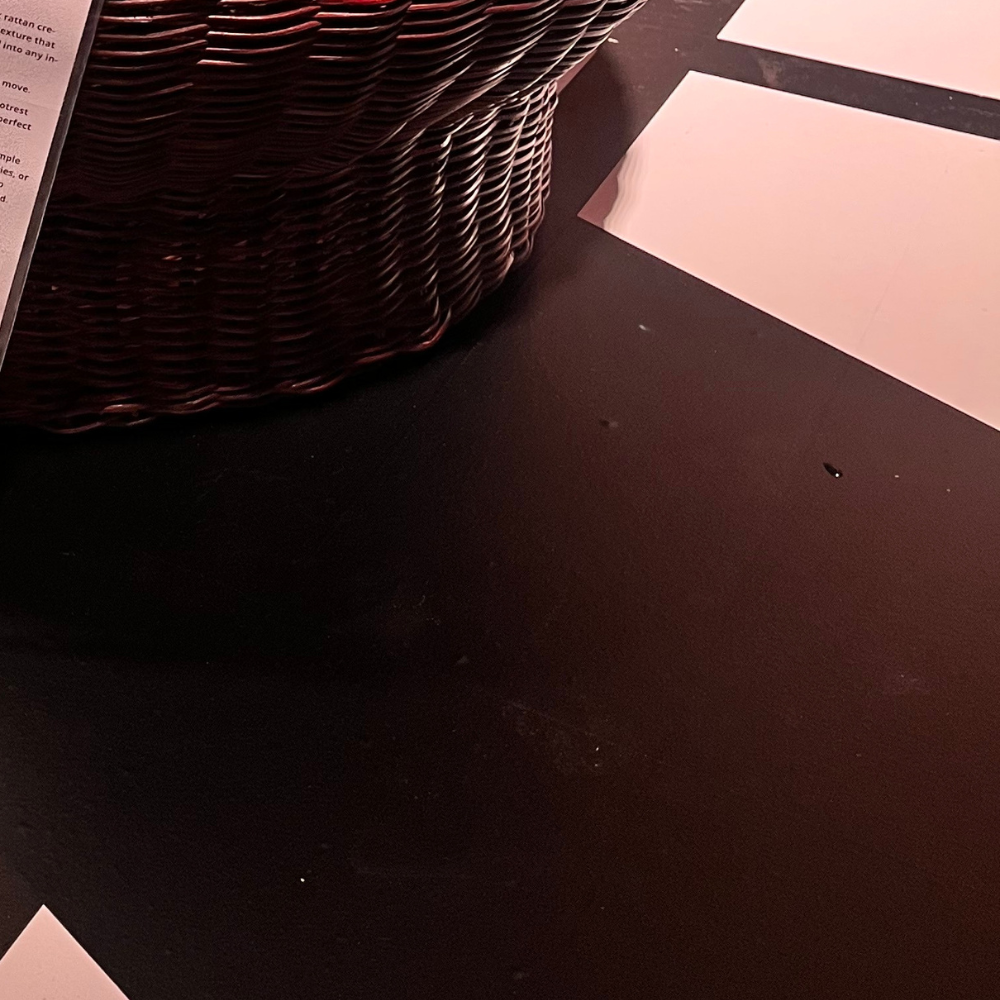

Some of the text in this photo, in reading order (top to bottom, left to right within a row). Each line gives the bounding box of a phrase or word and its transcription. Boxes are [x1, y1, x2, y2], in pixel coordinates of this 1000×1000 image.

[3, 14, 35, 29] rattan
[36, 24, 56, 34] cre-
[34, 37, 56, 49] that
[2, 41, 23, 54] into
[24, 49, 44, 61] any
[44, 53, 59, 63] in-
[18, 173, 30, 181] or
